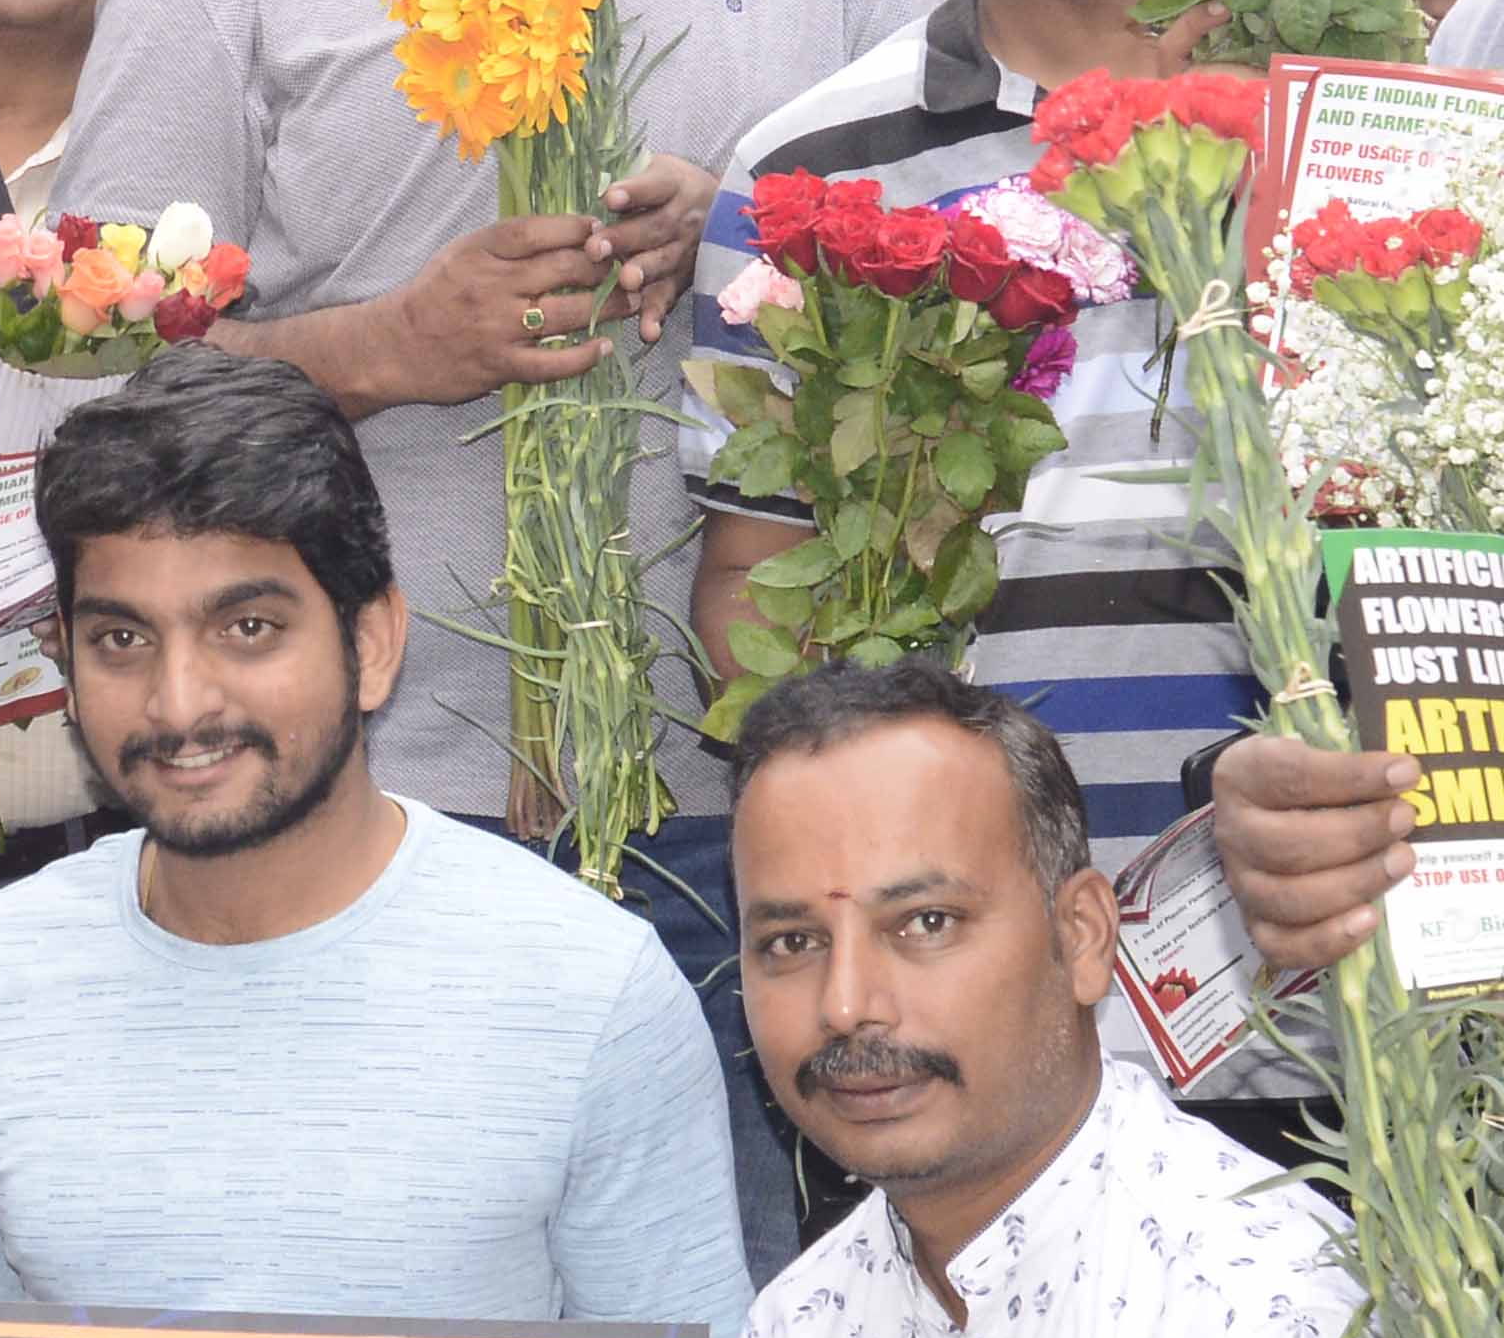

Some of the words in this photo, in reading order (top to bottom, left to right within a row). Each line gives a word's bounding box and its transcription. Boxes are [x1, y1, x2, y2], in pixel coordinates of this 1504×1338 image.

[1321, 81, 1369, 102] SAVE
[1374, 86, 1438, 110] INDIAN
[1316, 108, 1355, 127] AND
[1310, 139, 1353, 156] STOP
[1358, 144, 1413, 164] USAGE
[1305, 163, 1385, 185] FLOWERS
[1373, 646, 1459, 686] JUST
[1442, 850, 1493, 865] yourself
[1412, 871, 1455, 888] STOP
[1459, 869, 1490, 885] USE
